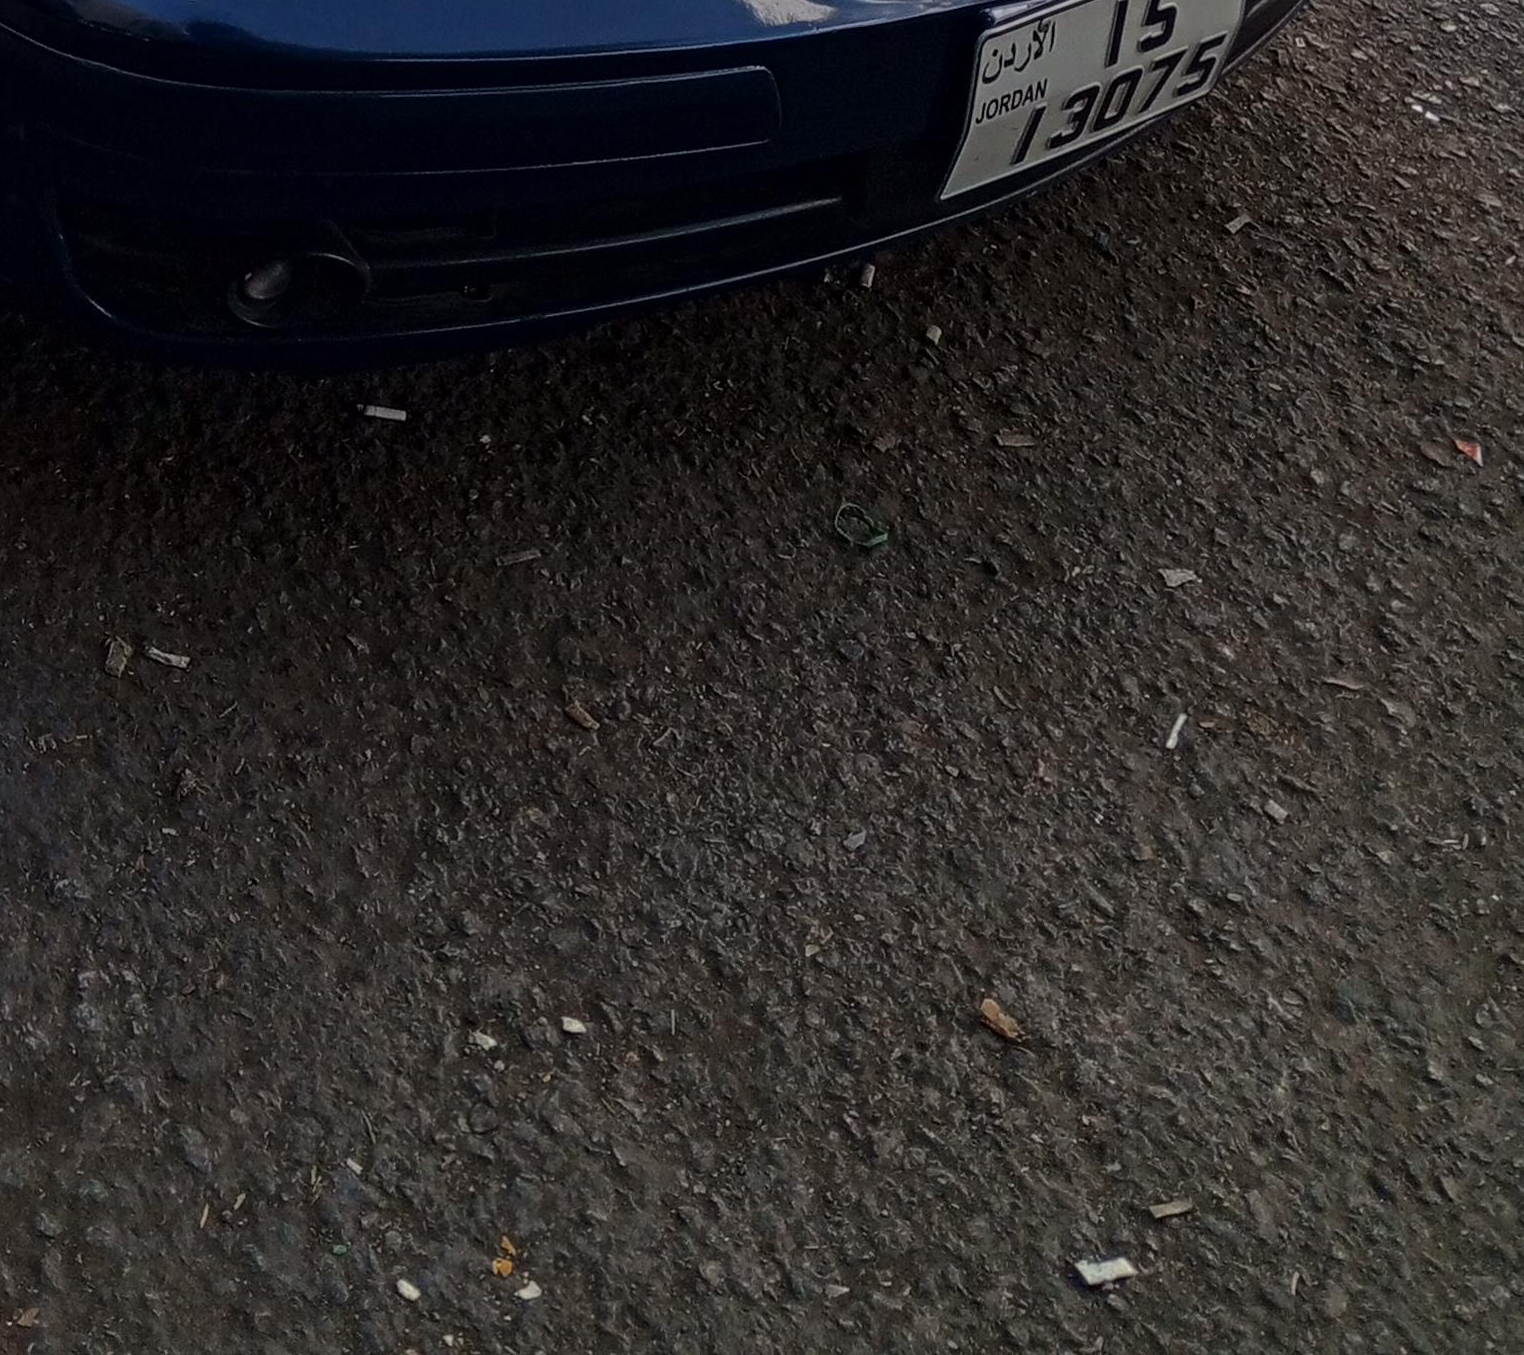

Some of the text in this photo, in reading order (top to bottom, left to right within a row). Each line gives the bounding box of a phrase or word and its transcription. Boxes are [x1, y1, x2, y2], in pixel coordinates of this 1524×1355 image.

[982, 18, 1055, 84] الأردن
[975, 78, 1048, 124] JORDAN
[1010, 33, 1227, 165] 13075
